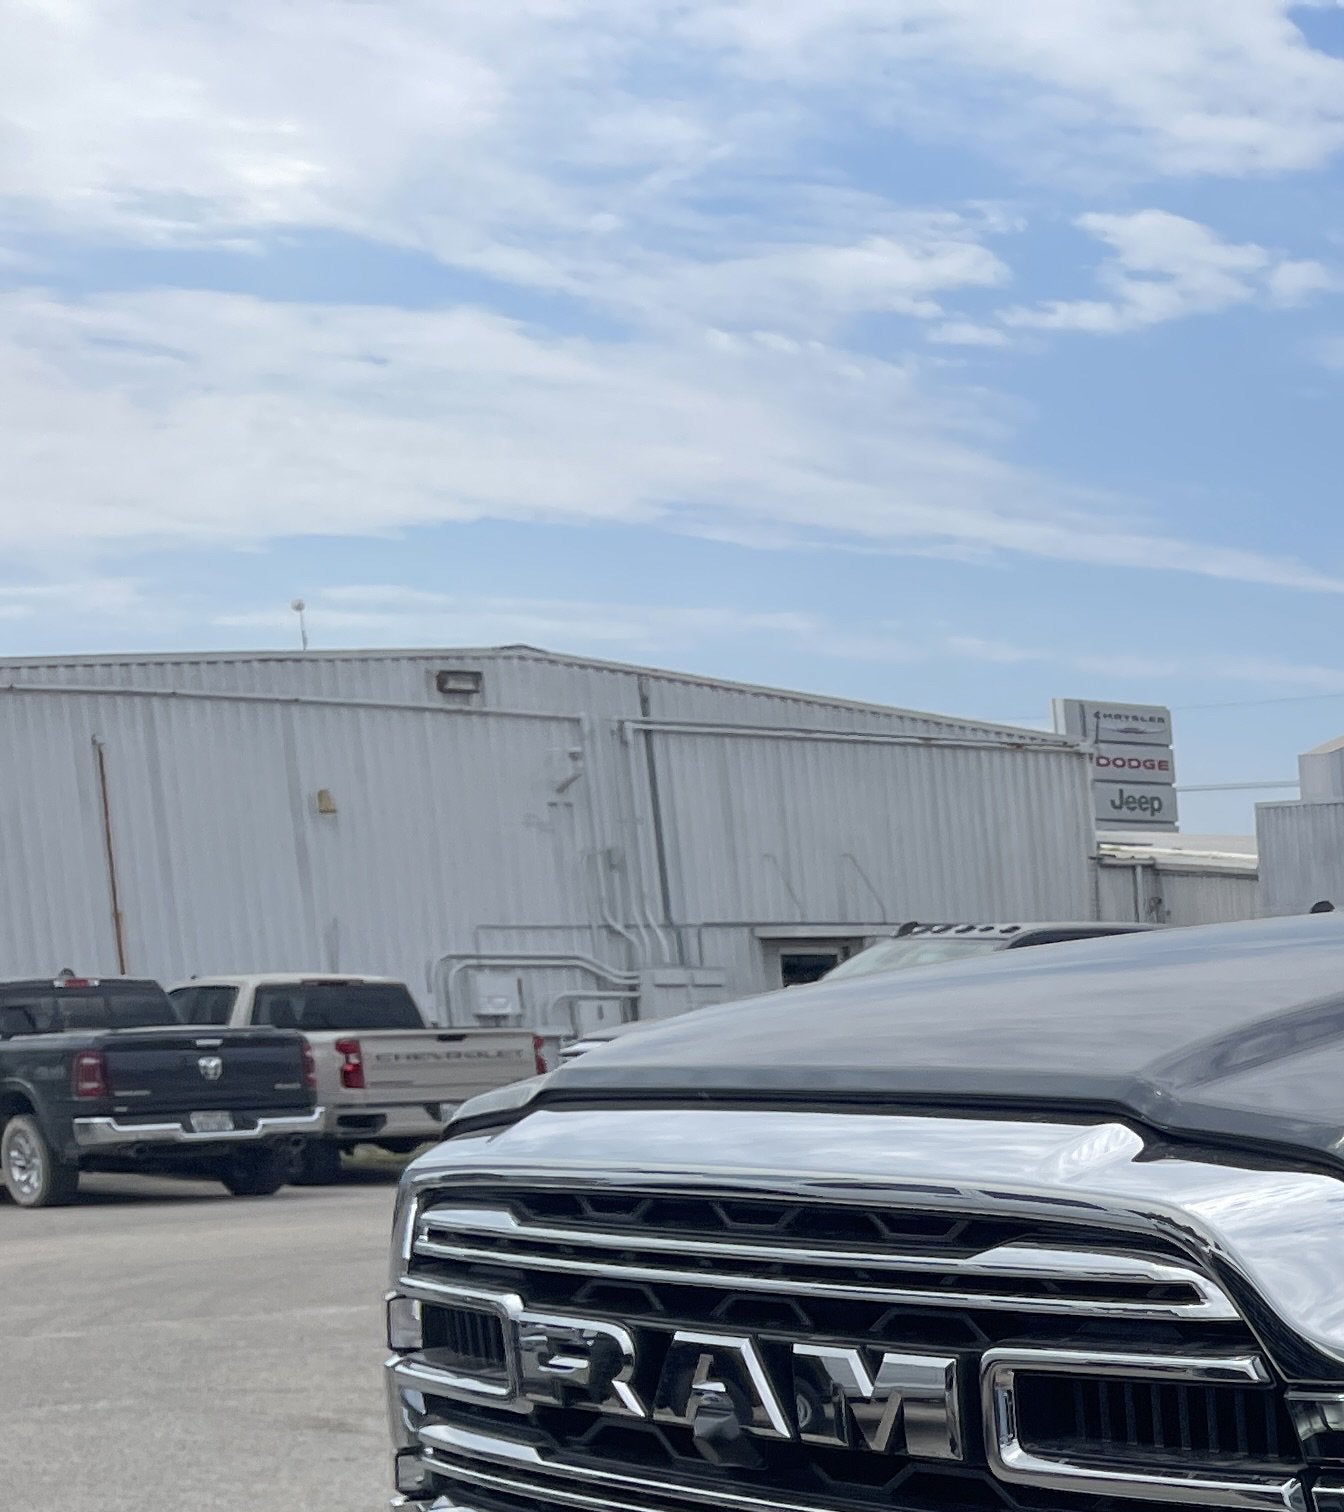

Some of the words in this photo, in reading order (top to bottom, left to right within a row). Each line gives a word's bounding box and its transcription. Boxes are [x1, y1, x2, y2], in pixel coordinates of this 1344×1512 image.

[1095, 755, 1170, 771] DODGE
[1110, 788, 1163, 816] Jeep
[518, 1309, 966, 1460] RAM
